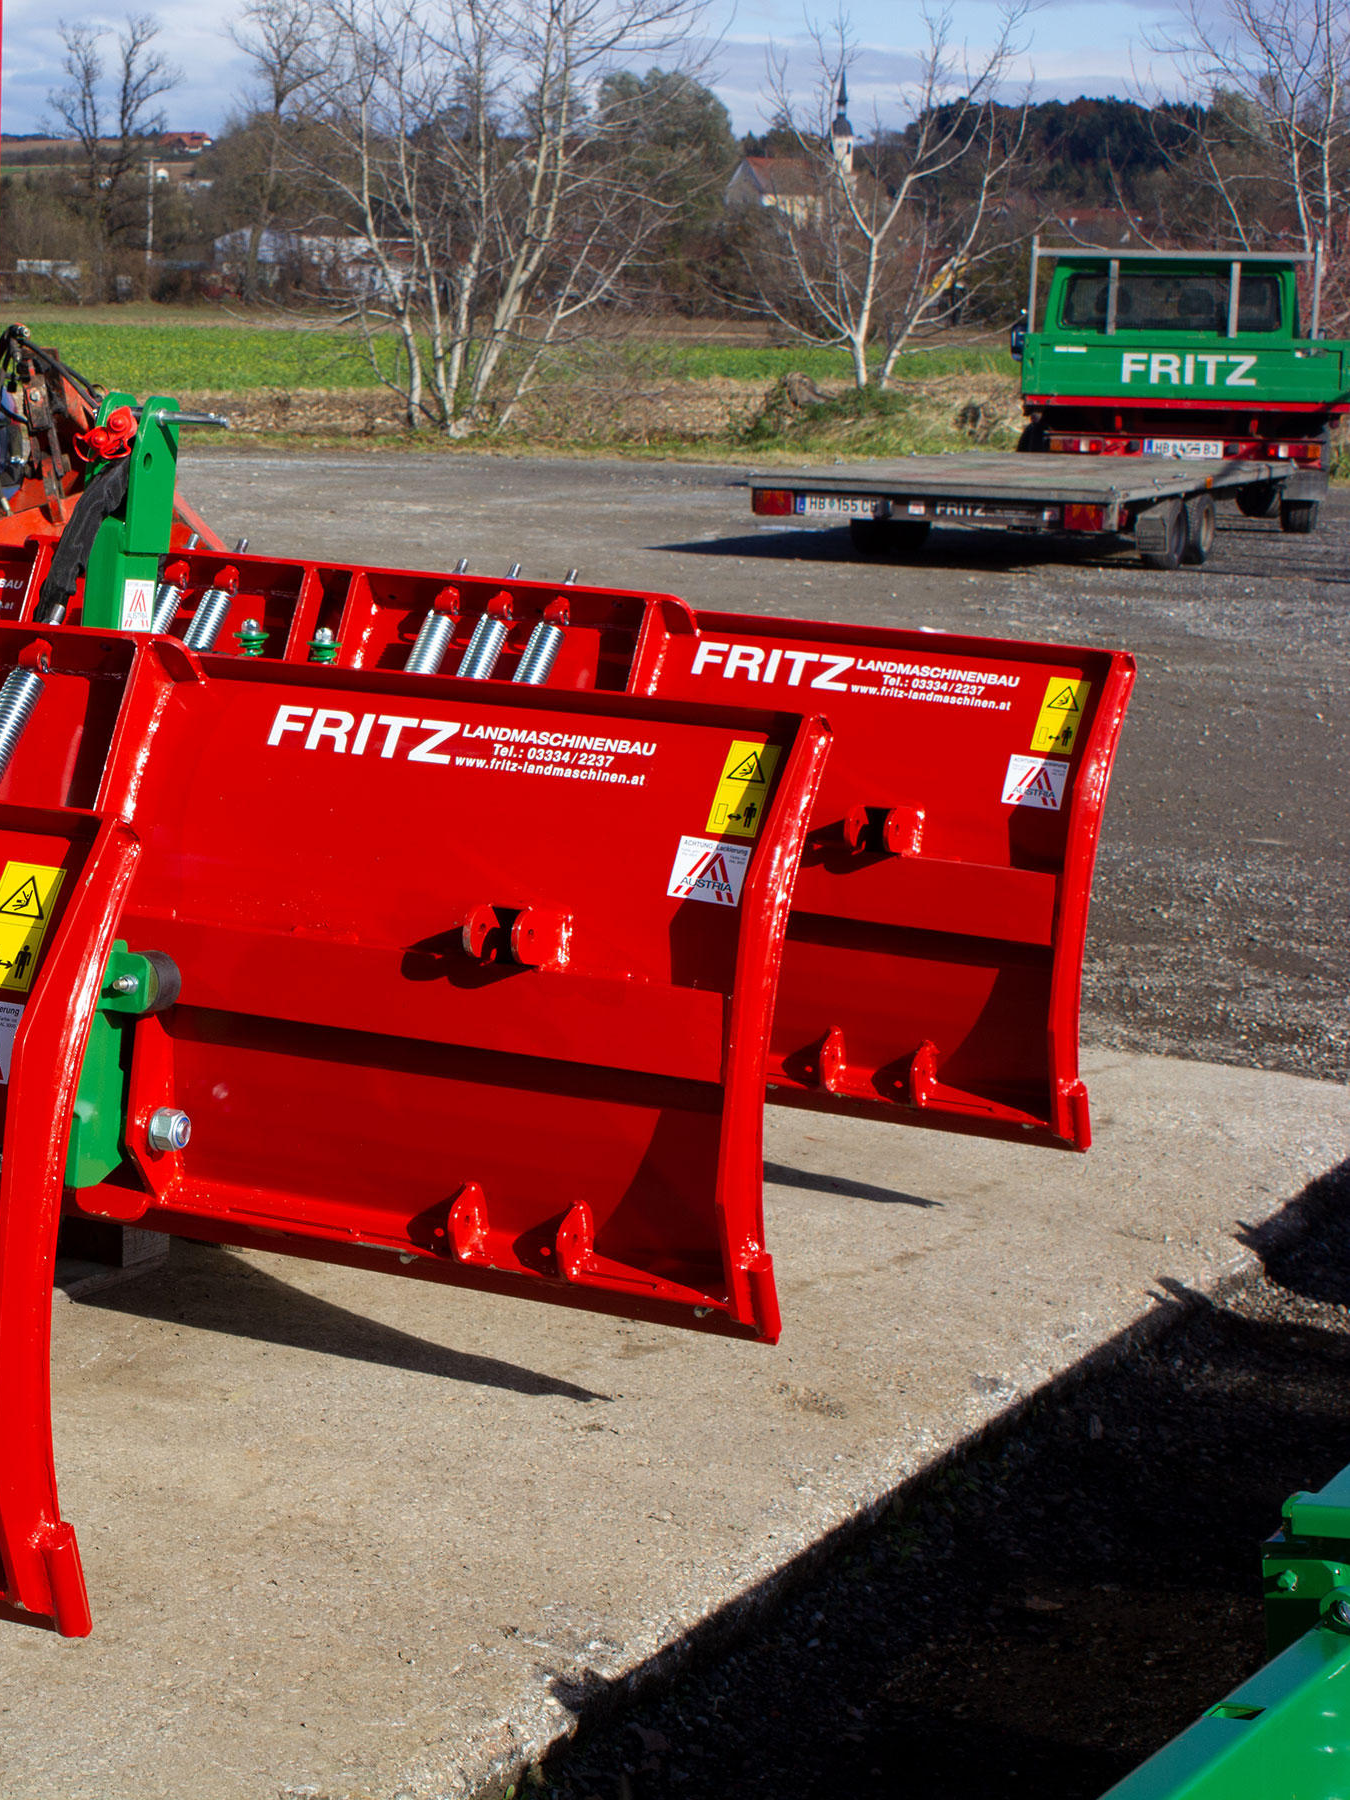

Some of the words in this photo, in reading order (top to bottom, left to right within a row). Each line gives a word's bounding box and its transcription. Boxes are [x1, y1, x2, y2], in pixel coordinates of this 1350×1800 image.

[1121, 352, 1258, 386] FRITZ
[810, 496, 826, 510] HB
[838, 497, 858, 512] 155
[936, 501, 986, 517] FRITZ
[690, 641, 855, 691] FRITZ
[856, 658, 1020, 688] LANDMASCHINENBAU
[851, 683, 1012, 711] www.fritz-landmaschinen.at
[882, 675, 909, 688] Tel.:
[911, 677, 985, 696] 03334/2237
[266, 704, 461, 765] FRITZ
[462, 723, 657, 757] LANDMASCHINENBAU
[492, 743, 524, 760] Tel.:
[527, 747, 615, 769] 03334/2237
[455, 755, 646, 786] www.fritz-landmaschinen.at
[1013, 786, 1056, 798] AUSTRIA
[680, 877, 732, 893] AUSTRIA
